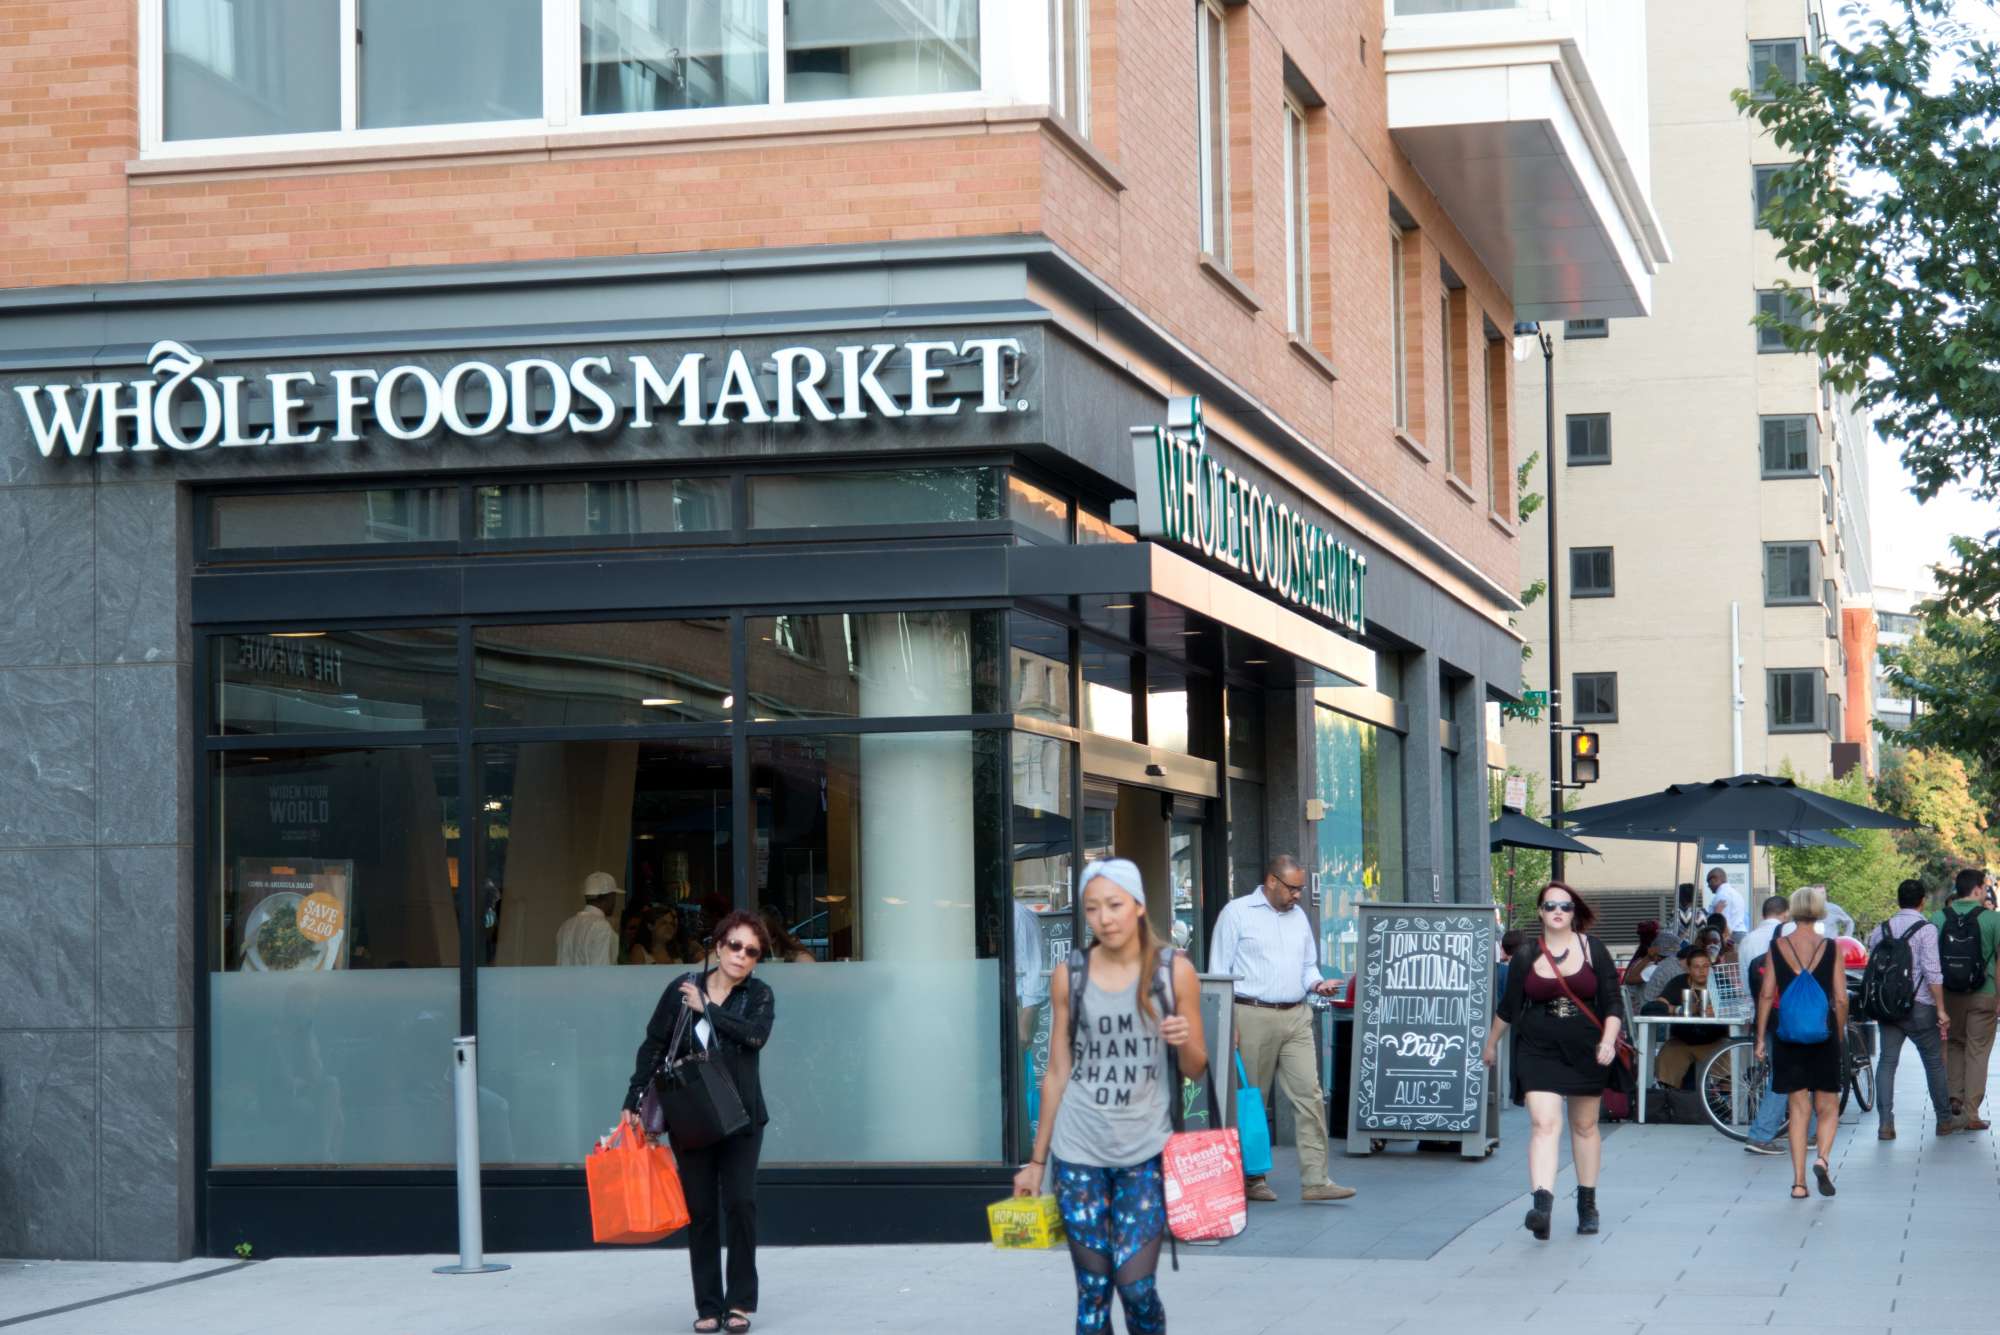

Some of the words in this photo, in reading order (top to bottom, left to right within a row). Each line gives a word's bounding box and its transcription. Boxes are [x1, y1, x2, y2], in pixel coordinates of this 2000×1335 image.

[13, 340, 321, 457] WHOLE
[330, 356, 616, 443] FOODS
[1154, 394, 1240, 566] WHOLE
[1238, 475, 1300, 605] FOODS
[1300, 517, 1367, 636] MARKET
[270, 800, 329, 825] WORLD
[303, 899, 339, 925] SAVE
[1384, 933, 1418, 964] JOIN
[1422, 933, 1441, 951] US
[1444, 934, 1471, 965] FOR
[1385, 953, 1469, 991] NATIONAL
[1098, 1013, 1133, 1035] OM
[1379, 995, 1469, 1026] WATERMELON
[1396, 1031, 1448, 1067] Day
[1095, 1087, 1131, 1107] OM
[1394, 1080, 1427, 1105] AUG
[1175, 1143, 1227, 1168] friends
